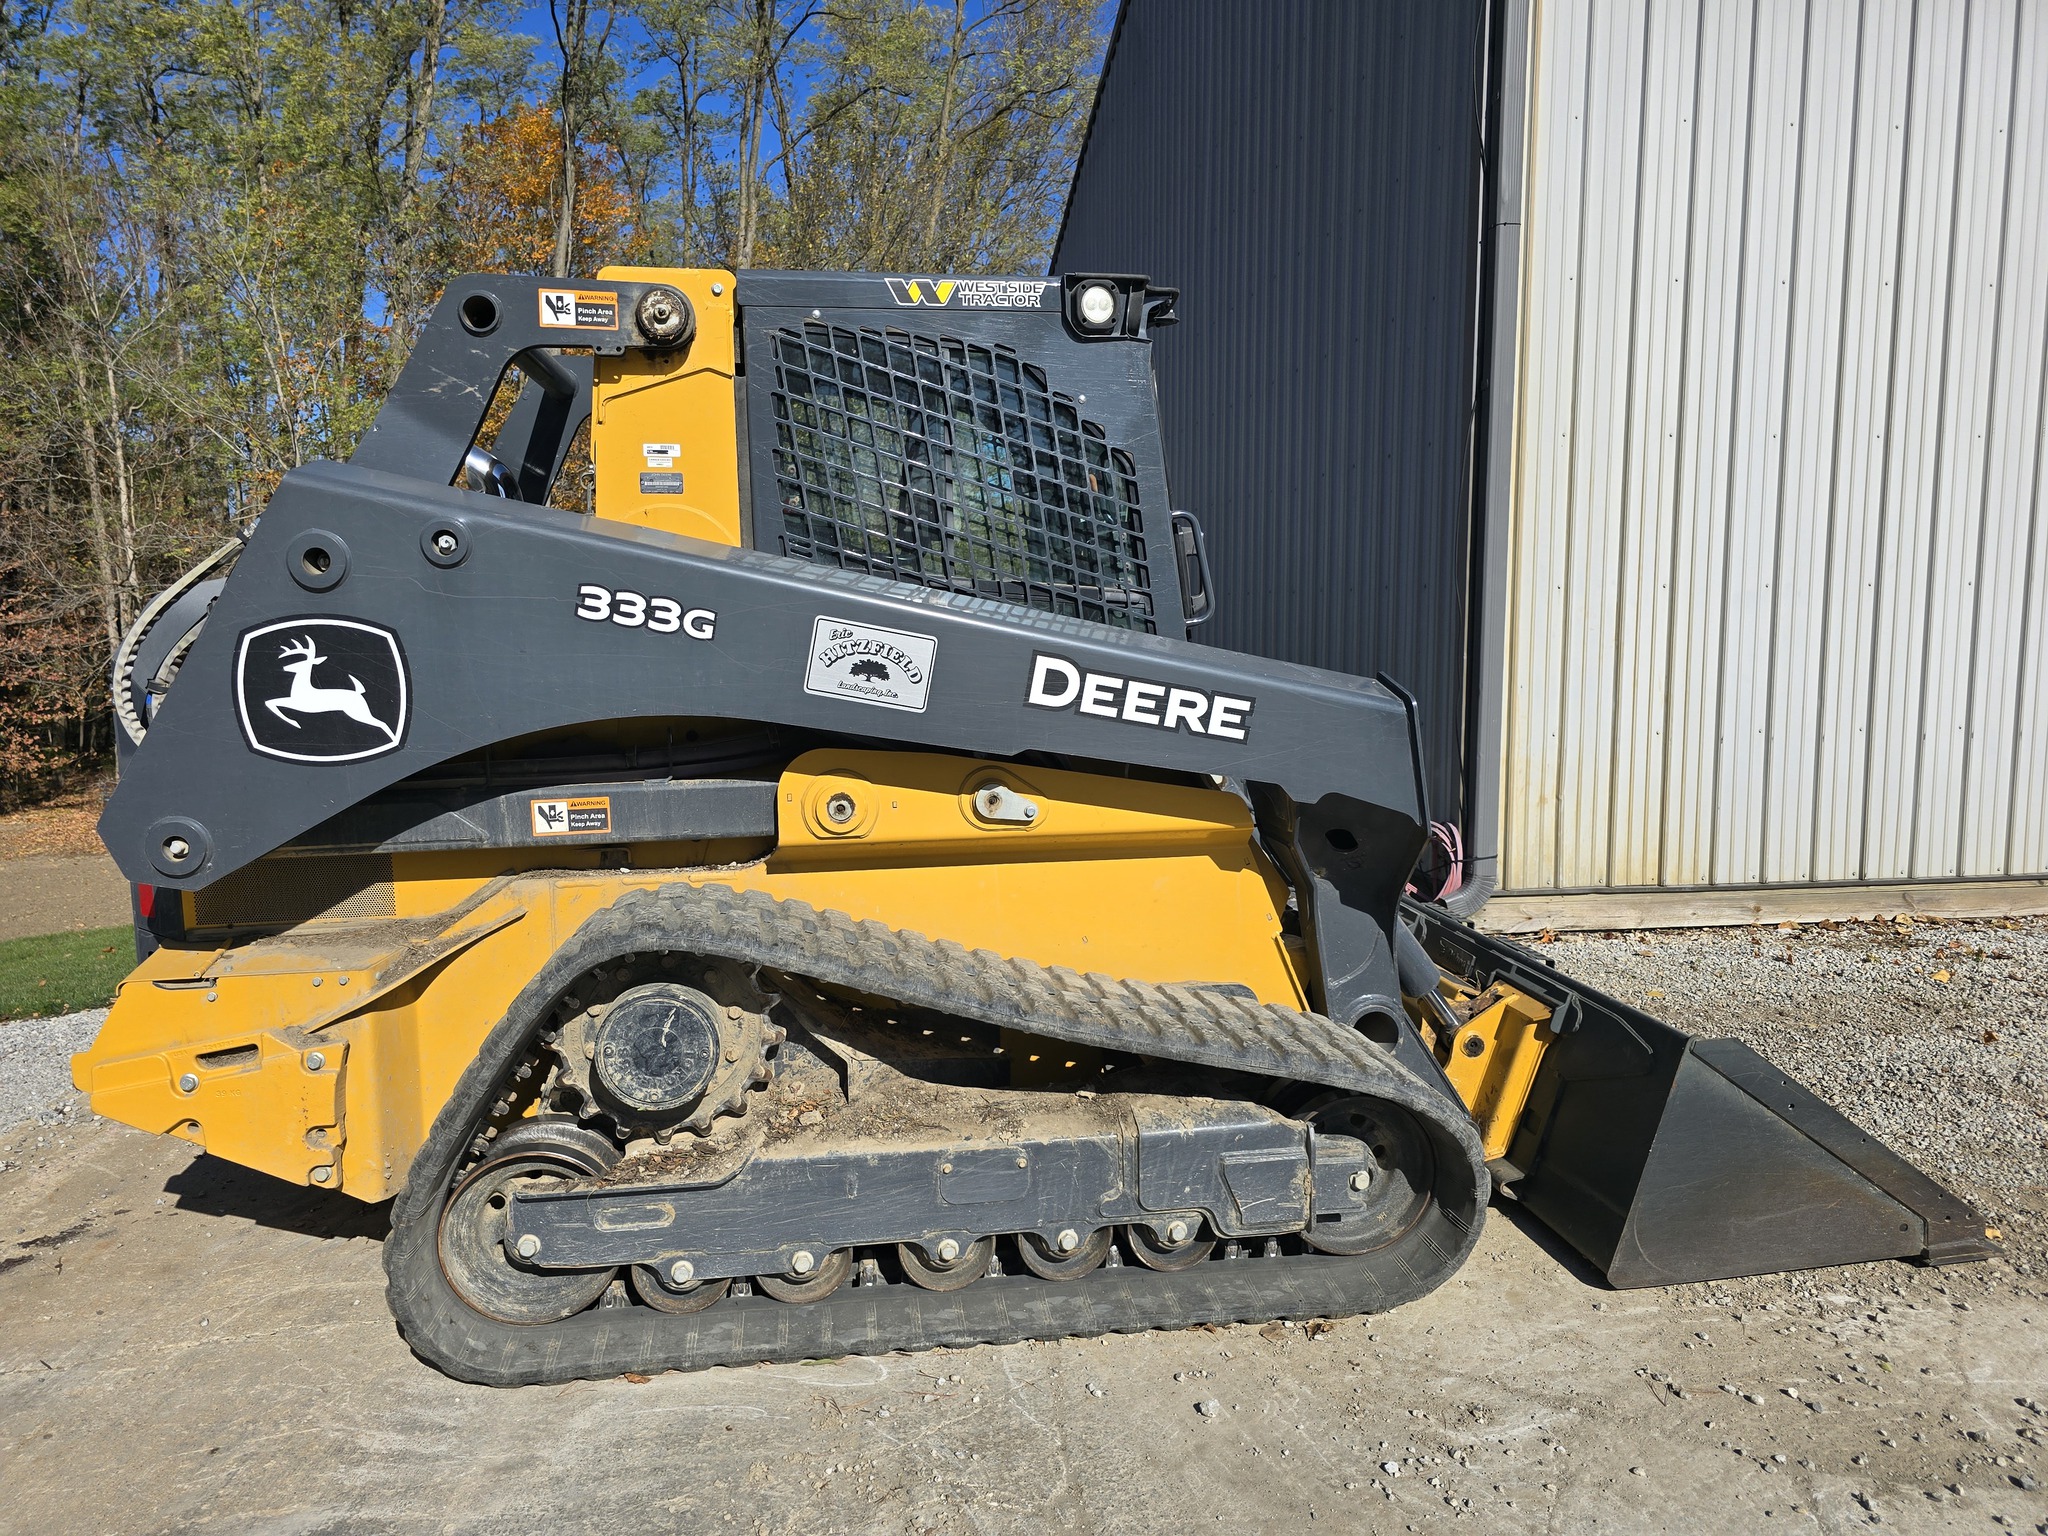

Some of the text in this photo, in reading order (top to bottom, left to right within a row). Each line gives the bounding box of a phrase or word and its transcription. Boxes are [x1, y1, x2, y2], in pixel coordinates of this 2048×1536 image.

[959, 280, 1044, 294] WEST SIDE
[584, 294, 614, 302] WARNING
[959, 293, 1042, 308] TRACTOR
[578, 307, 613, 316] Pinch Area
[593, 316, 609, 324] Away
[576, 584, 717, 640] 333G
[828, 627, 853, 641] Eric
[818, 639, 923, 685] HITZFIELD
[884, 688, 899, 699] Inc.
[1028, 655, 1252, 740] DEERE
